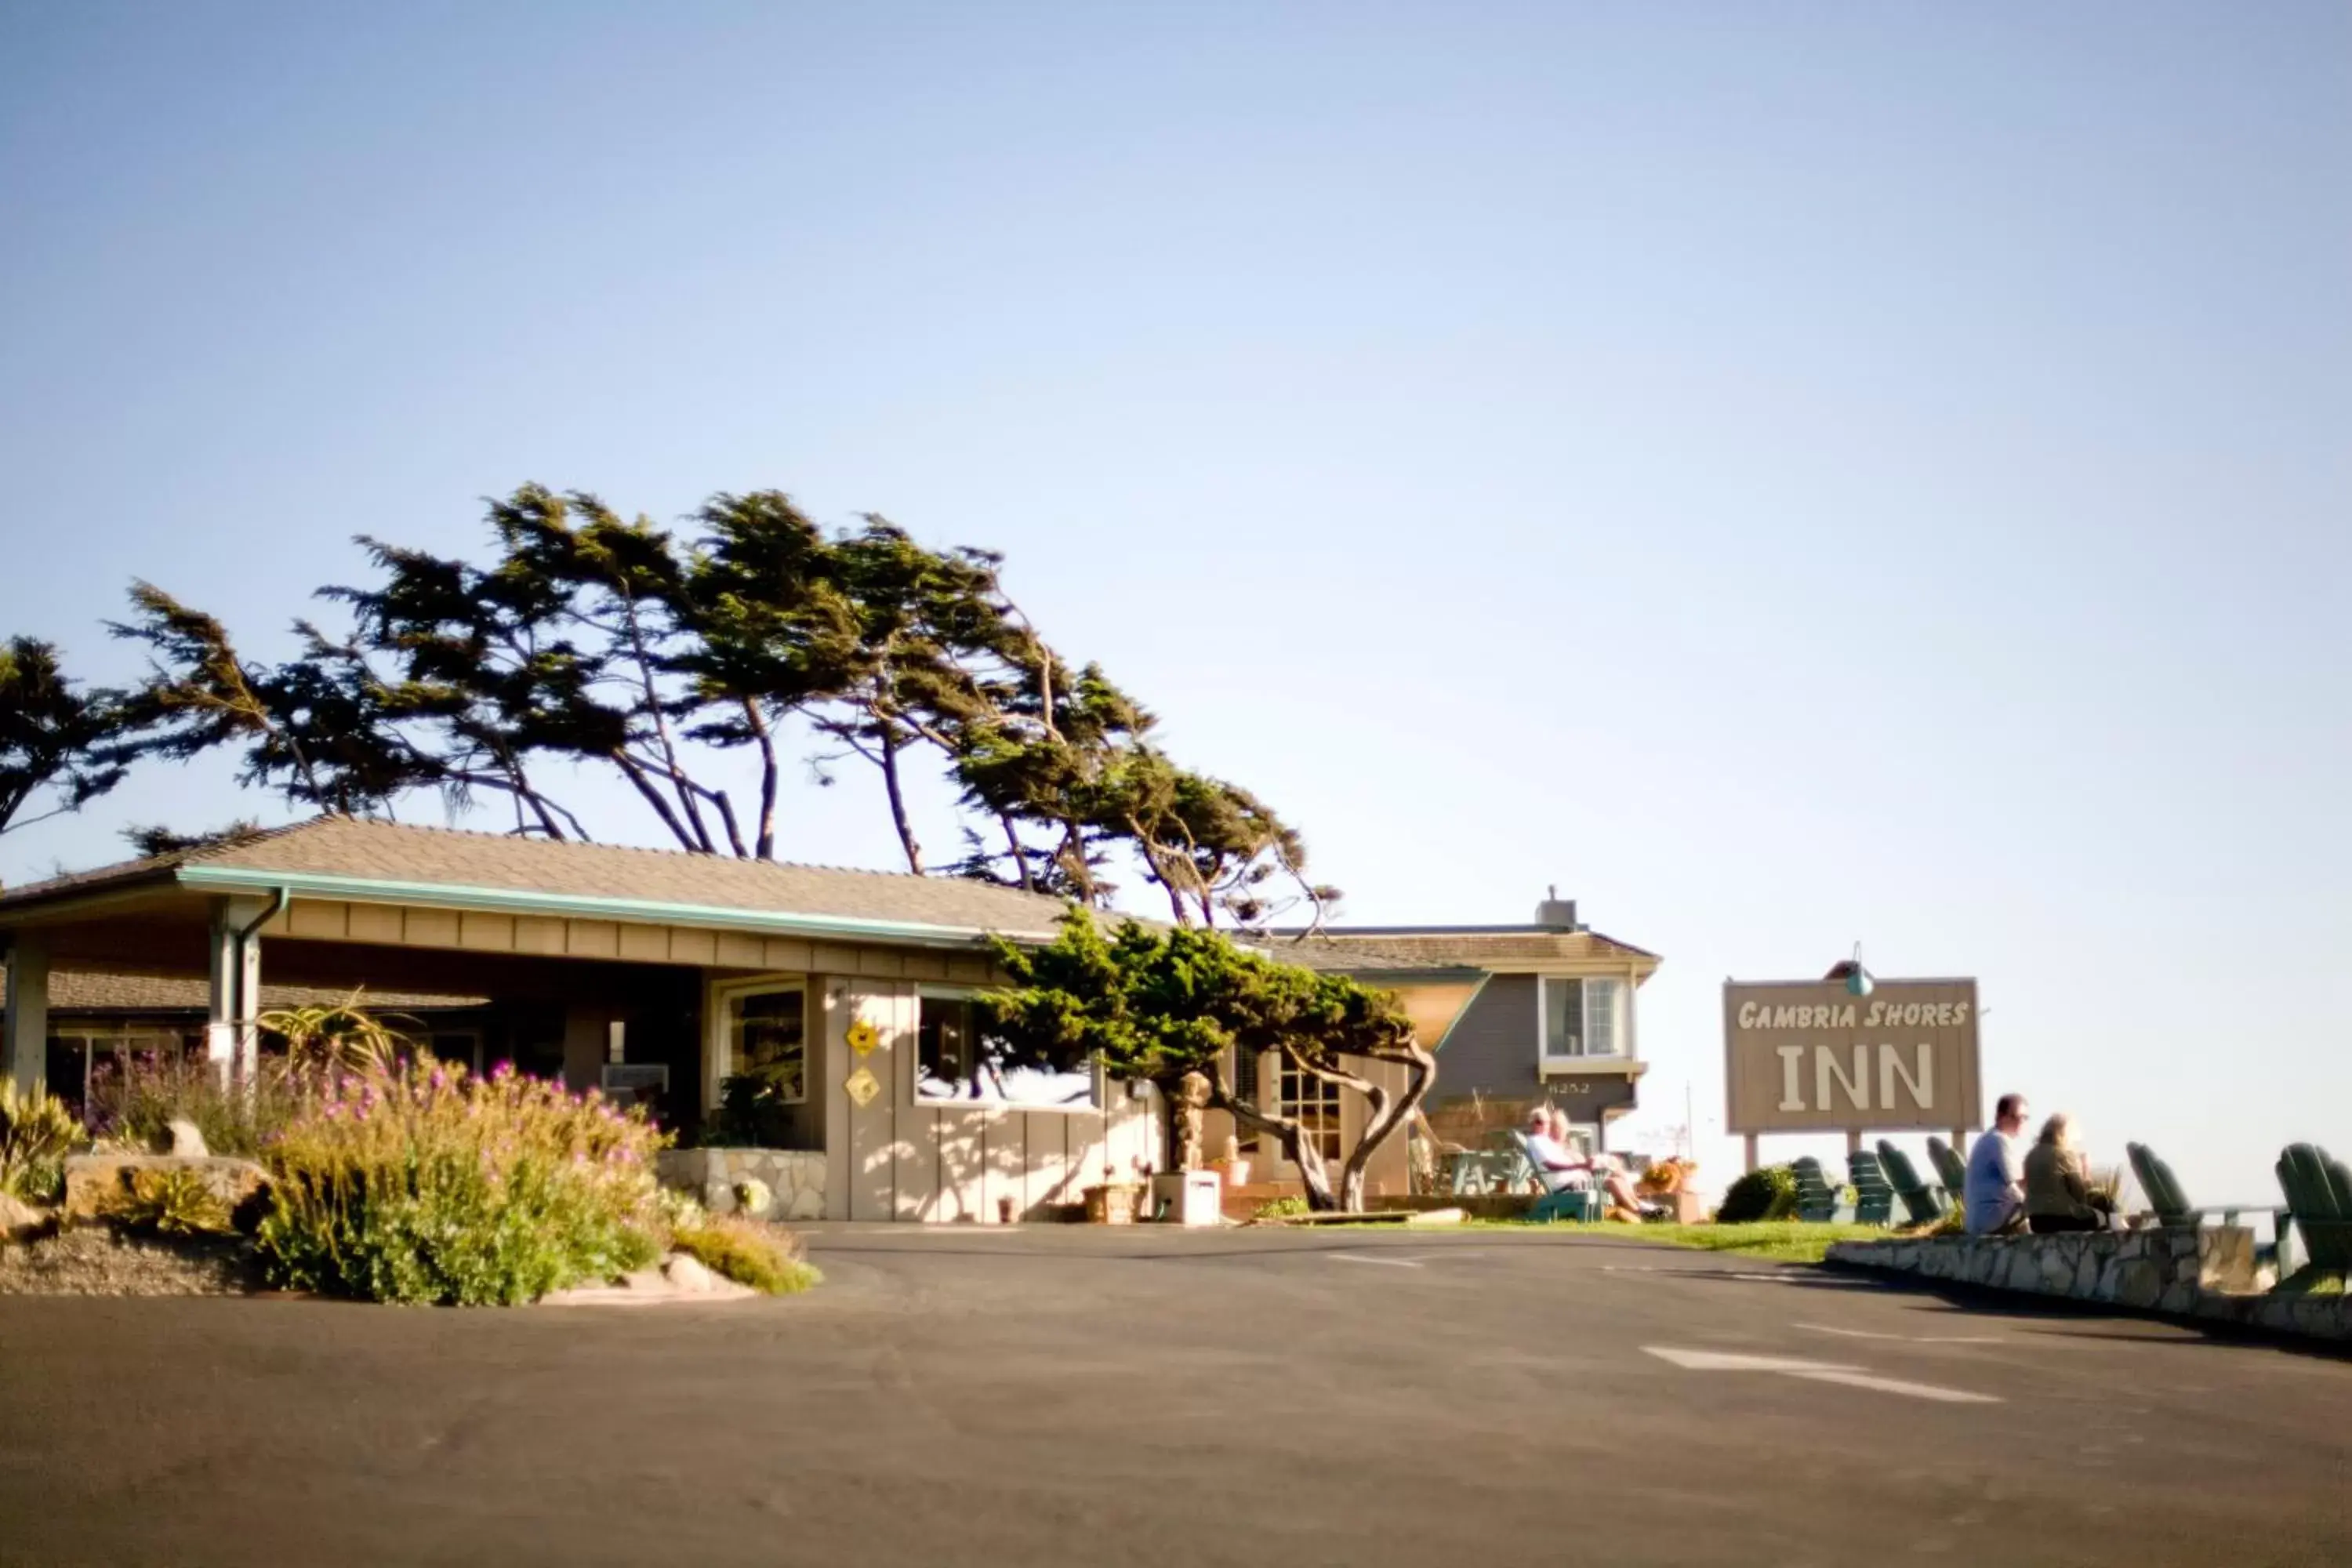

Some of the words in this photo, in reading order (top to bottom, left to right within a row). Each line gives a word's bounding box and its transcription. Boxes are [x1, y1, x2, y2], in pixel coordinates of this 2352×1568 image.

[1739, 1000, 1855, 1029] CAMBRIA
[1864, 1000, 1969, 1027] SHORES
[1777, 1044, 1933, 1110] INN
